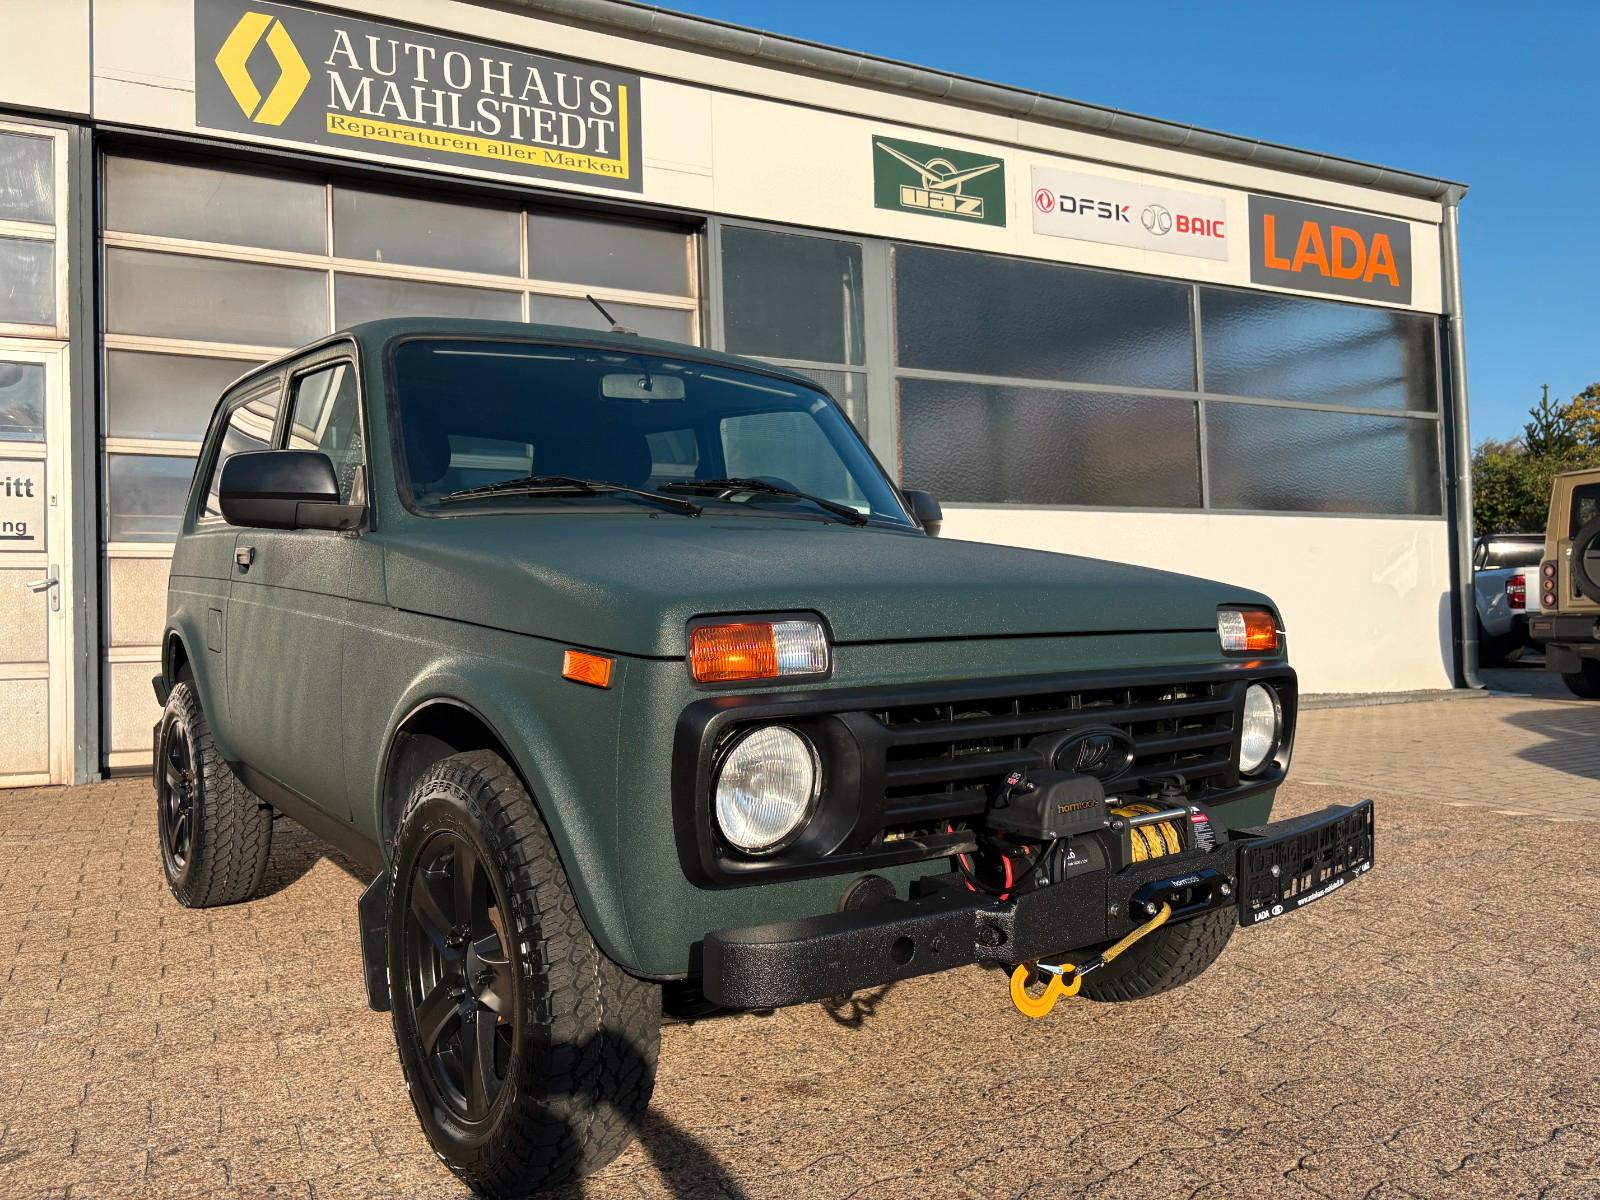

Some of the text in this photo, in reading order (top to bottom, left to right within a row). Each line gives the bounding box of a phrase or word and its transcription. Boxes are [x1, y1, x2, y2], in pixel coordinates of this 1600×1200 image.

[324, 29, 614, 117] AUTOHAUS
[326, 70, 615, 154] MAHLSTEDT
[329, 116, 625, 175] Reparaturen aller Marken
[1059, 194, 1131, 224] DFSK
[1176, 214, 1225, 239] BAIC
[1263, 214, 1400, 287] LADA
[1254, 910, 1270, 922] LADA
